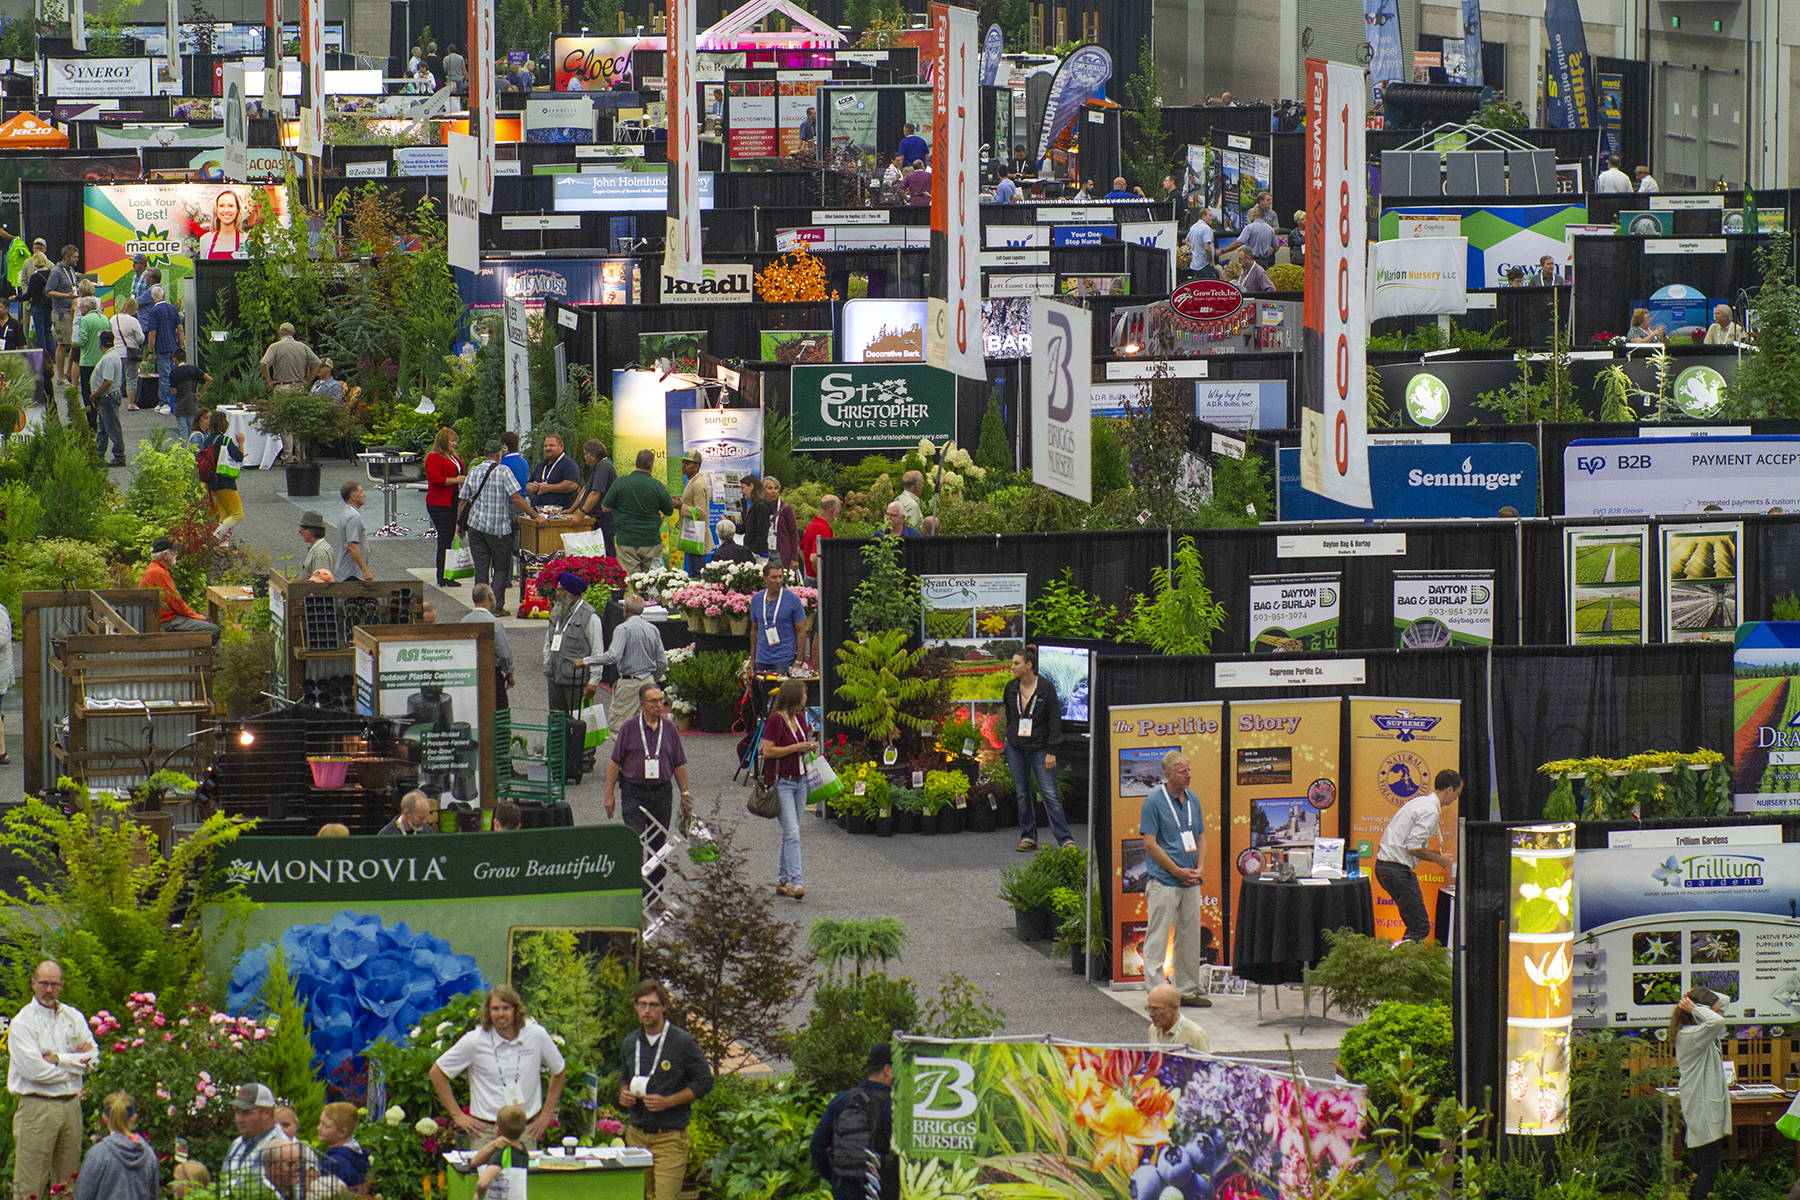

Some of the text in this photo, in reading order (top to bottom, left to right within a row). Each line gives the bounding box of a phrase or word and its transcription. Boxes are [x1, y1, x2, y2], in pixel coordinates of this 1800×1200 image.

[1376, 35, 1392, 44] Two
[938, 14, 947, 115] Farwest
[64, 64, 133, 80] SYNERGY
[1312, 70, 1324, 191] Farwest
[593, 176, 668, 188] John Holmlund
[129, 198, 176, 208] Look Your
[957, 41, 966, 354] 17000
[136, 208, 168, 220] Best!
[126, 242, 180, 254] macore
[1384, 268, 1406, 282] Marion
[1408, 270, 1440, 281] Nursery
[506, 276, 567, 296] Soil Moist
[664, 274, 750, 294] kradl
[1335, 103, 1350, 478] 18000
[821, 373, 875, 404] St.
[1208, 386, 1252, 400] Why buy from
[821, 394, 930, 427] CHRISTOPHER
[842, 420, 921, 428] NURSERY
[857, 433, 949, 442] www.stchristophernursery.com
[1048, 422, 1074, 454] BRIGGS
[1577, 456, 1606, 474] EVO
[1618, 455, 1652, 470] B2B
[1692, 454, 1752, 466] PAYMENT
[1408, 468, 1522, 491] Senninger
[1731, 499, 1762, 507] payments
[1340, 540, 1349, 548] Bag
[1355, 540, 1371, 548] Burlap
[922, 578, 947, 589] Ryan
[948, 578, 976, 588] Creek
[1428, 585, 1467, 594] DAYTON
[1281, 588, 1316, 598] DAYTON
[1254, 599, 1316, 610] BAG & BURLAP
[1398, 596, 1467, 605] BAG & BURLAP
[1254, 612, 1307, 622] 503-951-3074
[434, 672, 471, 680] Containers
[1269, 668, 1294, 676] Supreme
[1296, 667, 1314, 676] Perlite
[1113, 717, 1219, 738] The Perlite
[1238, 714, 1302, 735] Story
[1386, 719, 1426, 728] SUPREME
[1386, 753, 1422, 770] NATURAL
[1361, 815, 1383, 824] Serving
[1676, 836, 1729, 846] Trillium Gardens
[473, 862, 520, 880] Grow
[524, 854, 616, 880] Beautifully
[1681, 855, 1764, 878] Trillium
[1686, 878, 1763, 888] gardens
[913, 1119, 977, 1135] BRIGGS
[913, 1134, 976, 1150] NURSERY
